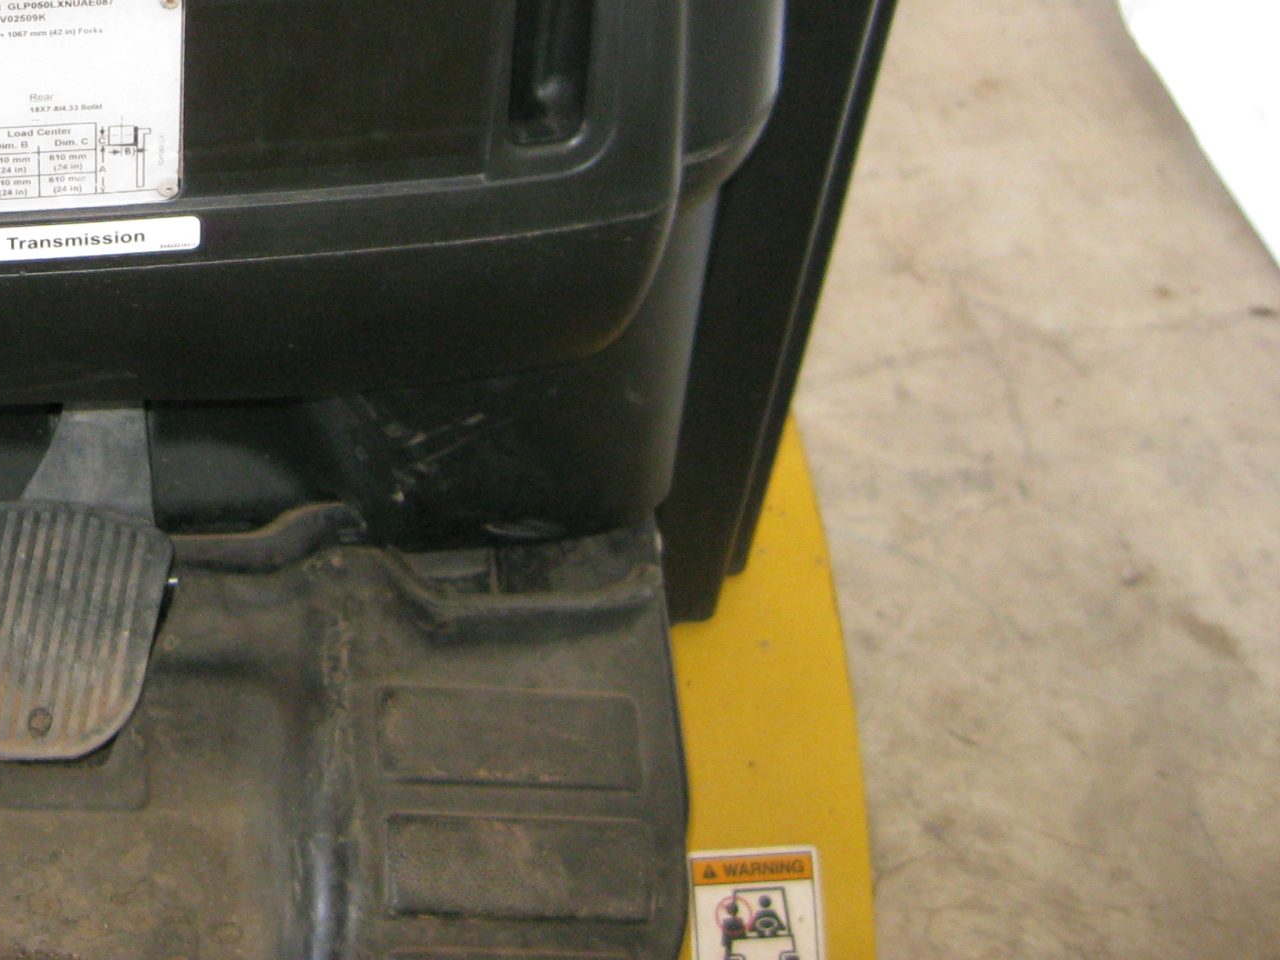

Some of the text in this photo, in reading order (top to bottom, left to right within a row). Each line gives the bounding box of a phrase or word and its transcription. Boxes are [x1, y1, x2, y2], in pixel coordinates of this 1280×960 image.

[49, 29, 62, 37] (42
[65, 28, 76, 36] in)
[30, 93, 53, 101] Rear
[7, 129, 33, 137] Load
[37, 128, 71, 136] Center
[54, 139, 77, 147] Dim.
[0, 189, 12, 197] (24
[16, 188, 27, 196] in)
[7, 231, 145, 251] Transmission
[723, 859, 804, 877] WARNING
